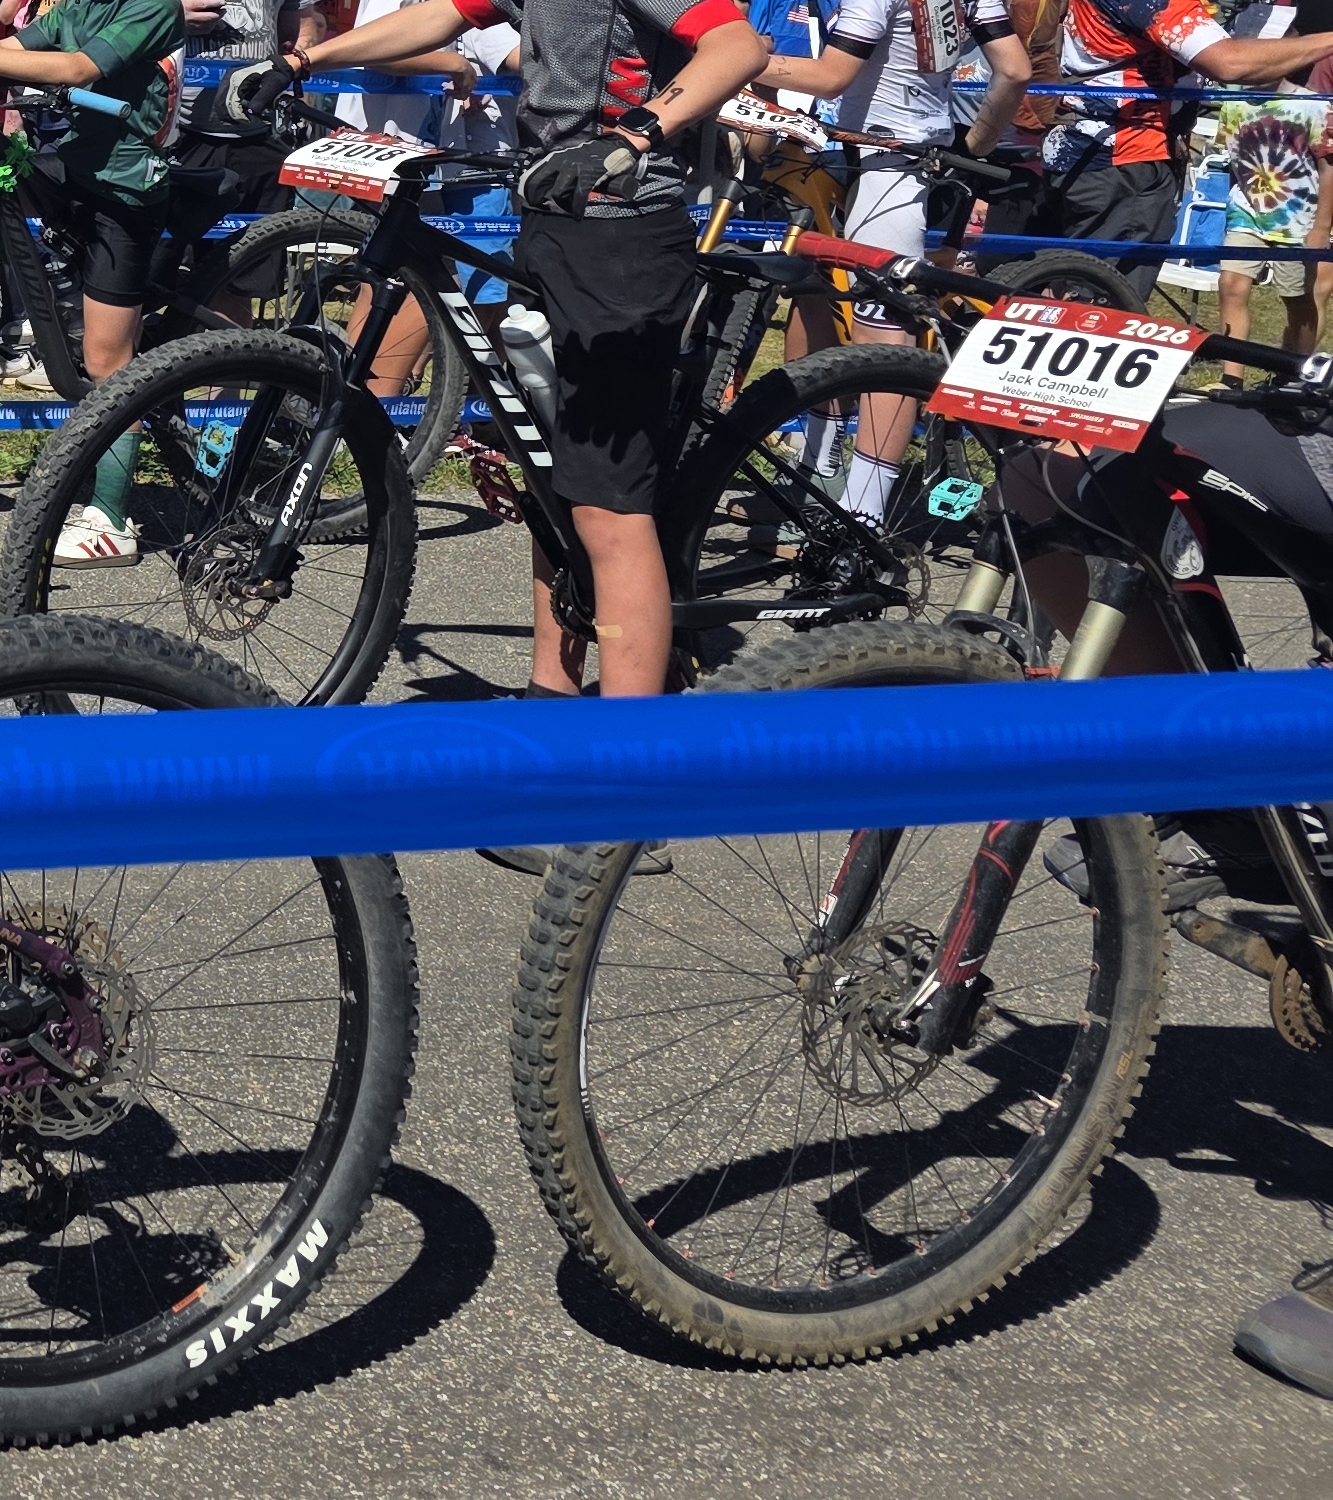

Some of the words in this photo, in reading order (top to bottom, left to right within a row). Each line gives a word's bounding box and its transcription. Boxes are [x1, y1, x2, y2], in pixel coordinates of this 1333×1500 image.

[312, 141, 407, 161] 51018
[1118, 319, 1192, 345] 2026
[982, 326, 1160, 389] 51016
[998, 371, 1033, 386] Jack
[1037, 376, 1109, 399] Campbell
[1001, 384, 1031, 398] Weber
[1033, 390, 1057, 404] High
[1057, 394, 1093, 409] School
[1018, 402, 1061, 417] TREK
[280, 462, 313, 527] AXON
[1198, 469, 1269, 512] EPIC
[757, 608, 831, 621] GIANT
[184, 1216, 331, 1370] MAXXIS
